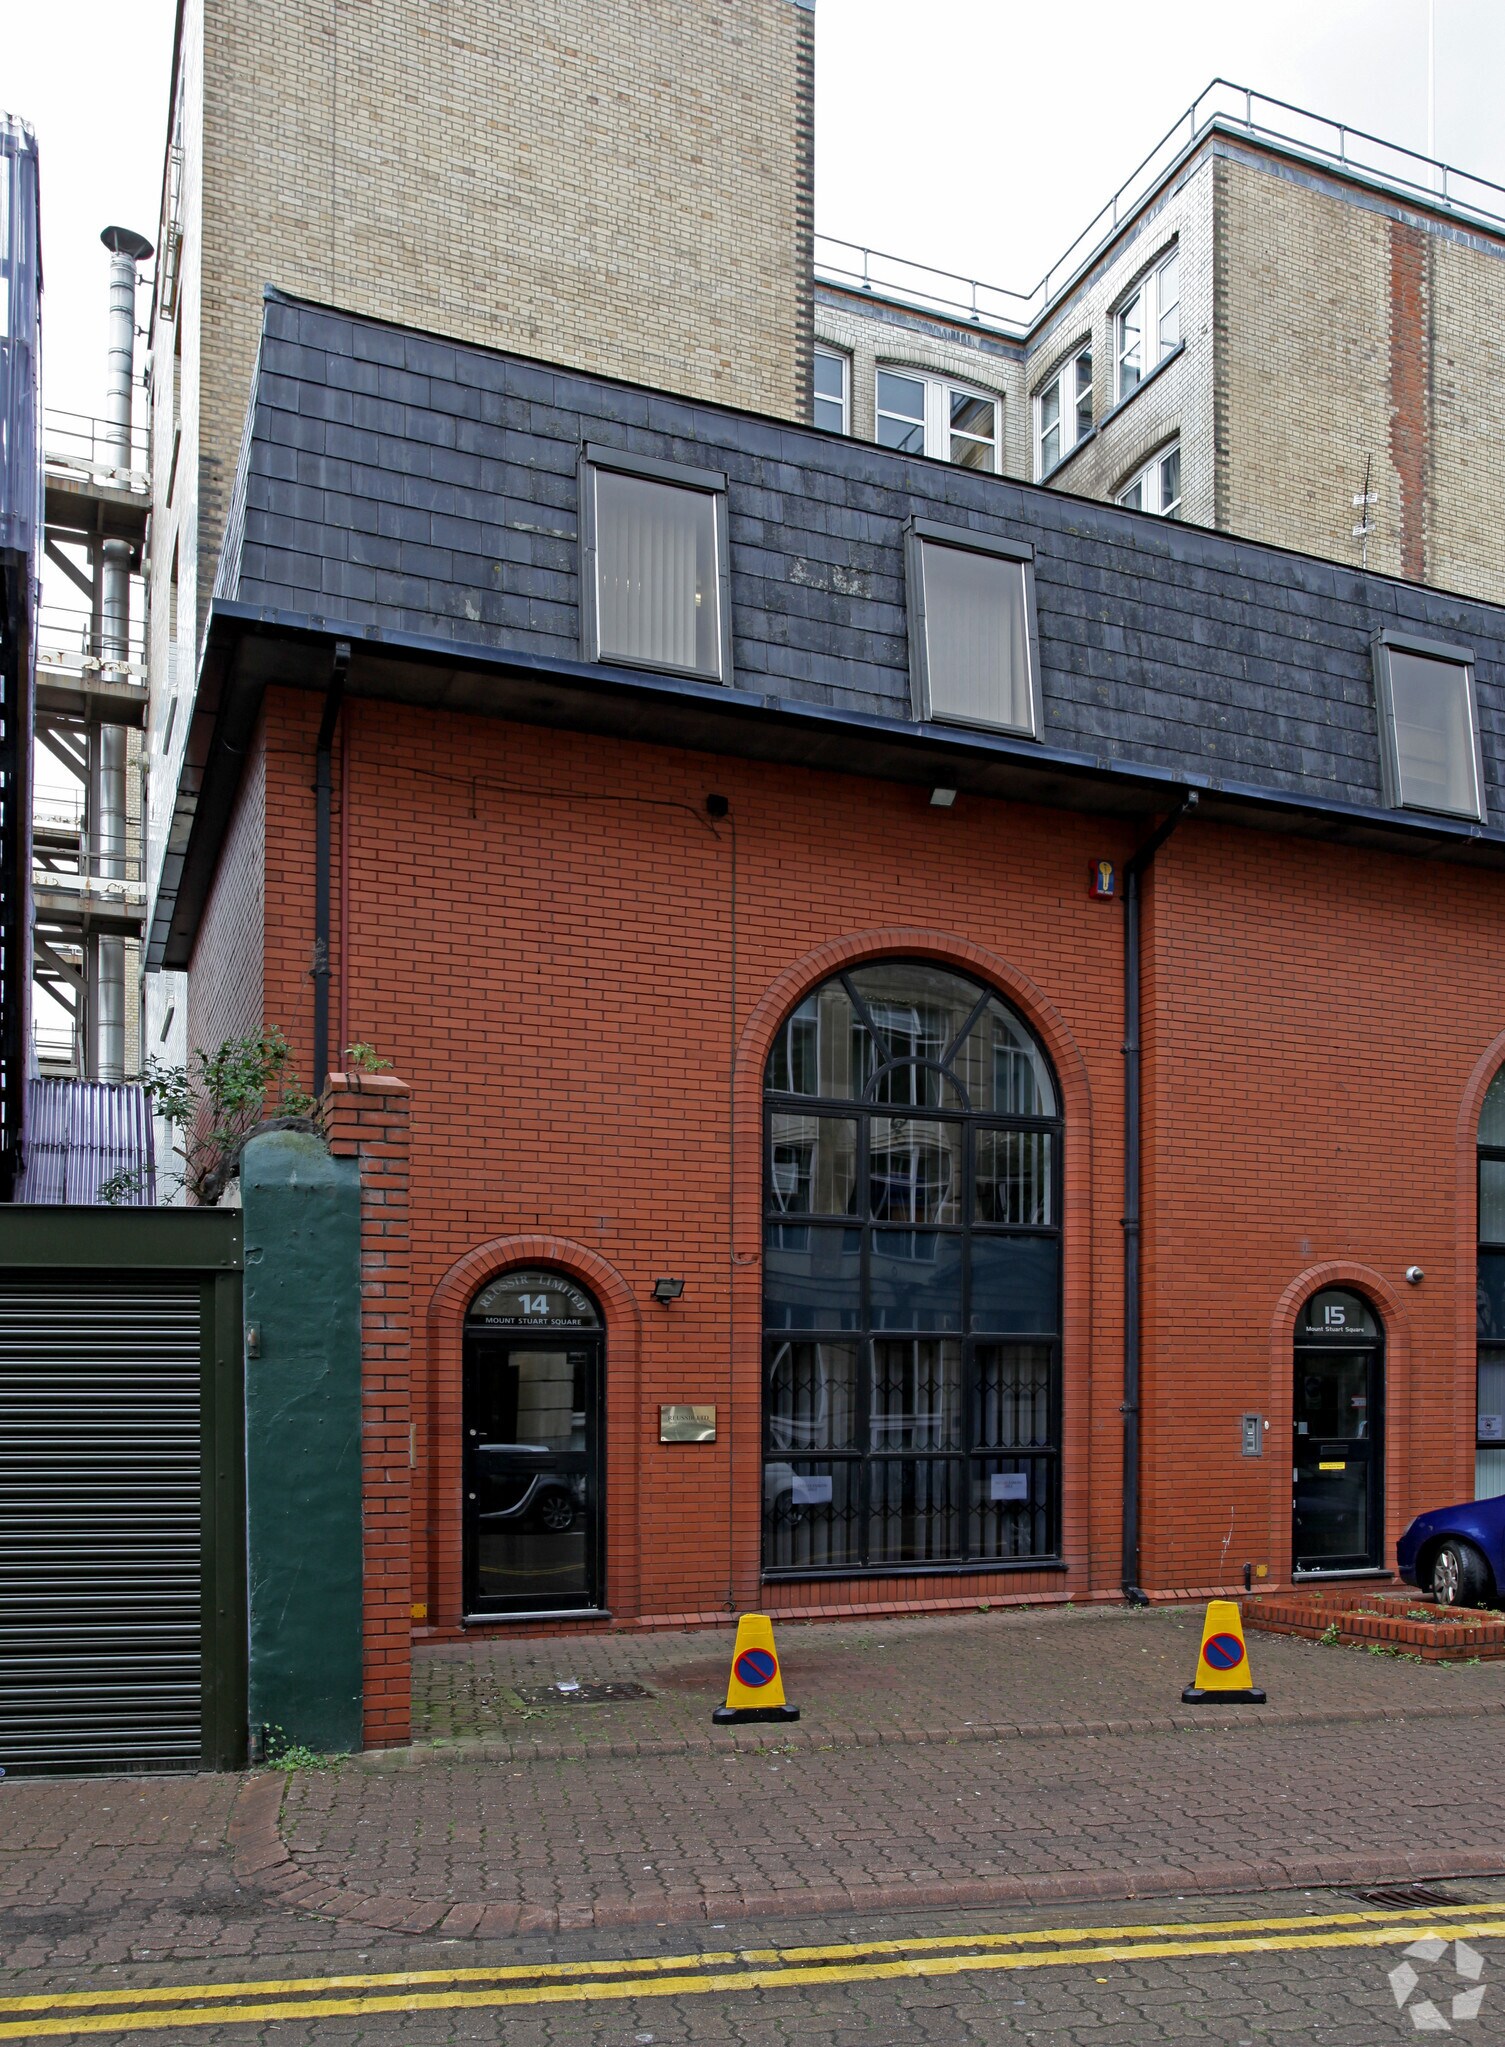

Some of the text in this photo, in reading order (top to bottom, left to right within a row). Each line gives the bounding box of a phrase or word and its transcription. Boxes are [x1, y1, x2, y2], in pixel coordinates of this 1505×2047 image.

[480, 1275, 587, 1311] REUSSIR LIMITED
[518, 1294, 550, 1315] 14
[518, 1317, 548, 1325] STUART
[551, 1318, 582, 1326] SQUARE
[1324, 1306, 1346, 1325] 15
